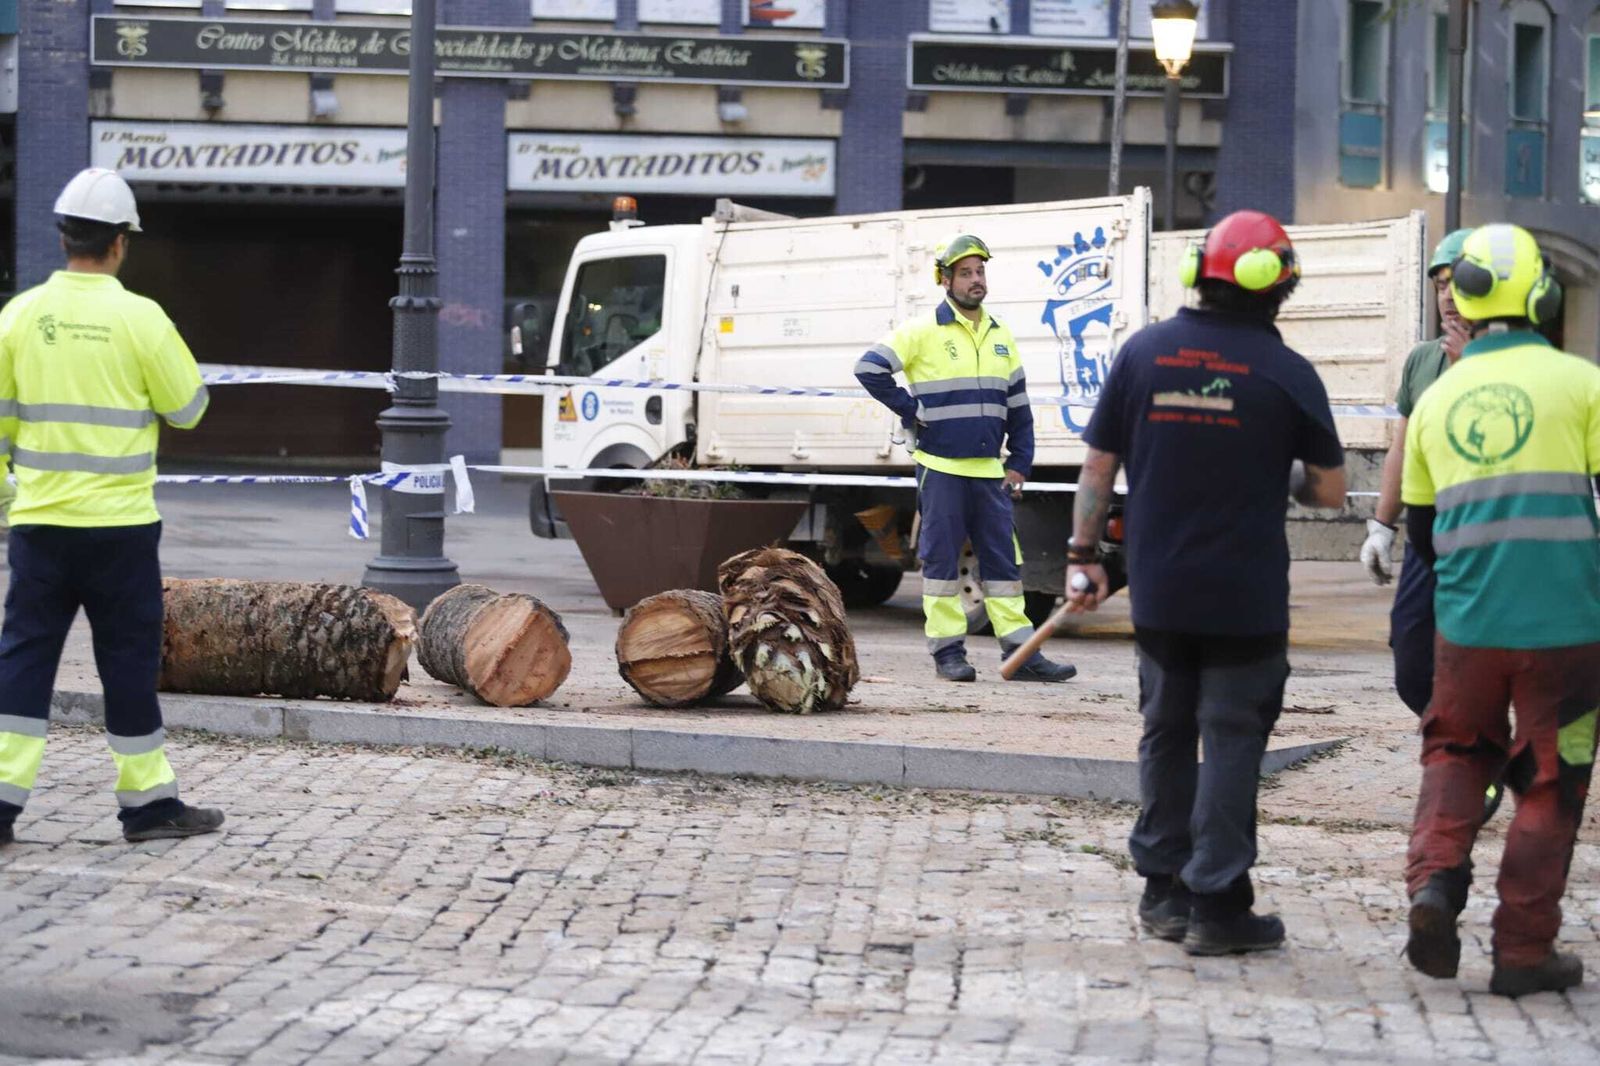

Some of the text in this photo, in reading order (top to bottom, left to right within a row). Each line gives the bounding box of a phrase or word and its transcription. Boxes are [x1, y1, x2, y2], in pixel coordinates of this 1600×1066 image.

[196, 24, 265, 50] Centro
[360, 30, 386, 55] de
[534, 44, 554, 67] y
[558, 36, 660, 62] Medicina
[117, 142, 359, 169] MONTADITOS
[533, 151, 763, 180] MONTADITOS
